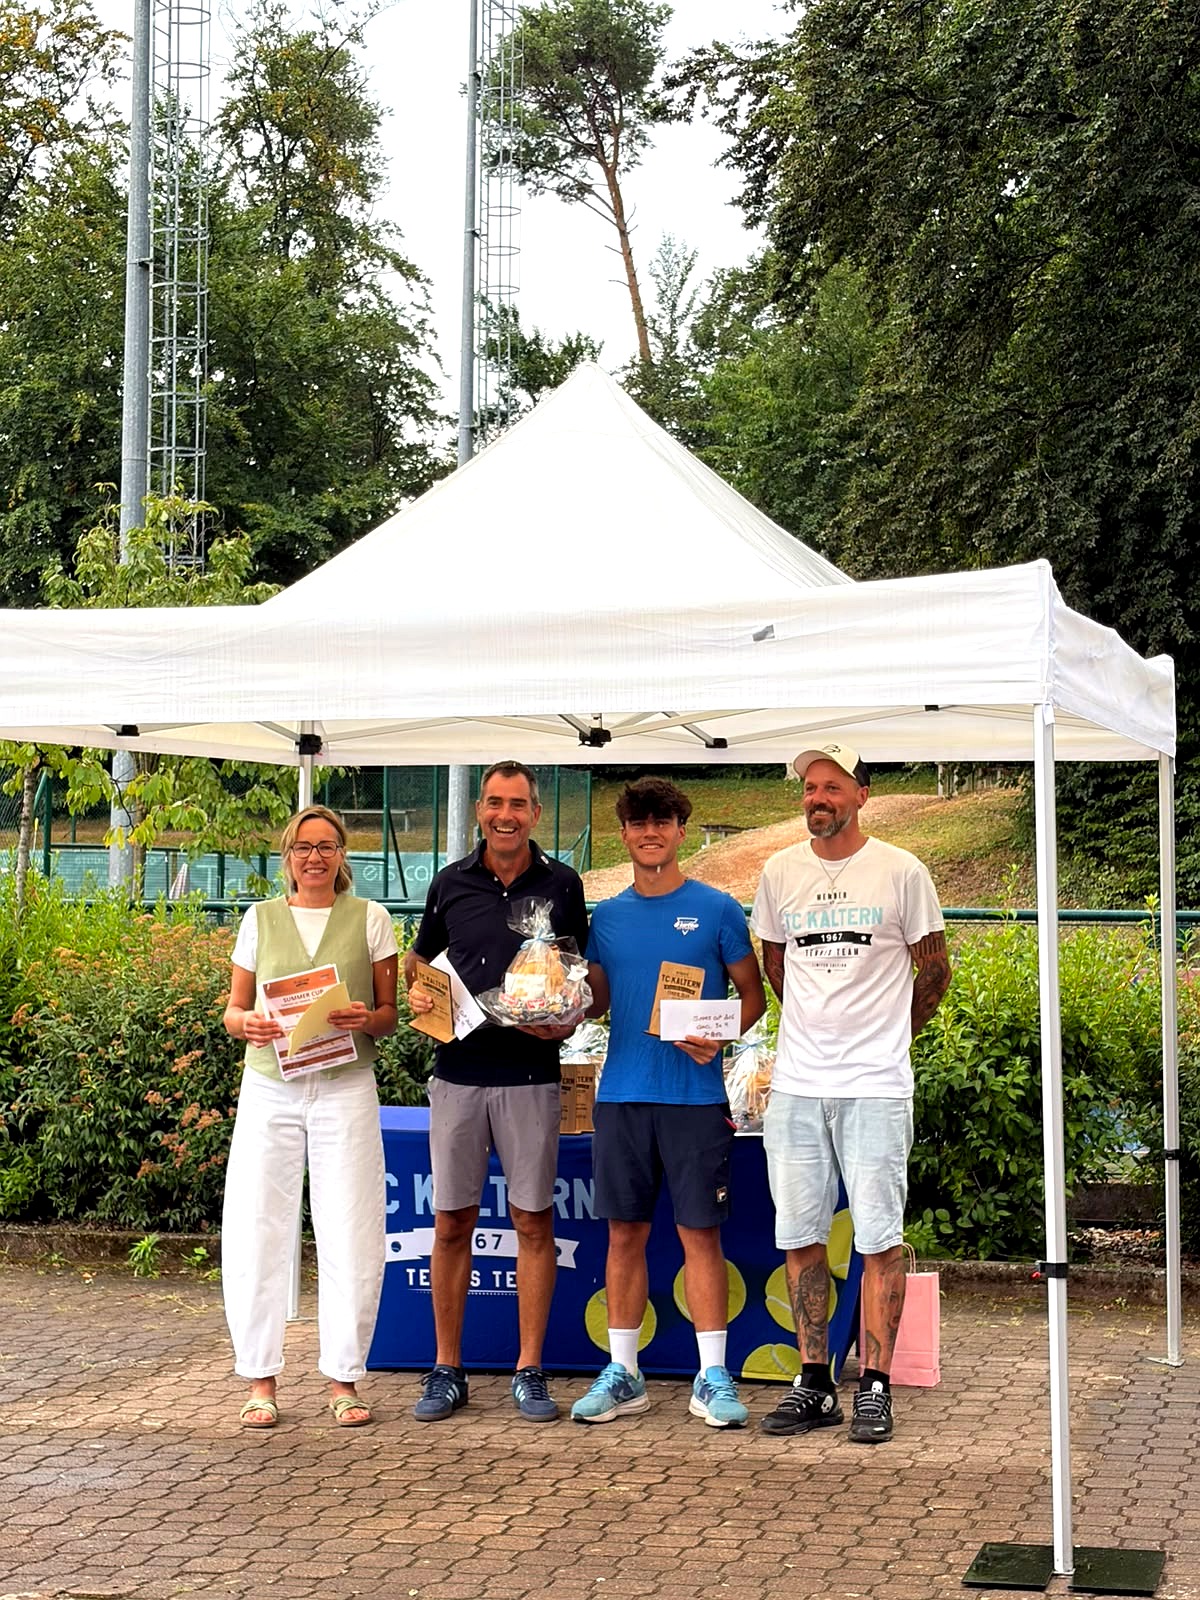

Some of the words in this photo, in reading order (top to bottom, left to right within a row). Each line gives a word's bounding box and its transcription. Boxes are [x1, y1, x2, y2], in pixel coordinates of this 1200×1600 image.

[816, 891, 847, 901] MEMBER
[784, 911, 802, 933] TC
[806, 906, 884, 929] KALTERN
[820, 933, 843, 943] 1967
[836, 947, 859, 956] TEAM
[661, 973, 671, 983] TC
[671, 976, 702, 989] KALTERN
[282, 991, 310, 1003] SUMMER
[311, 988, 324, 998] CUP
[385, 1173, 400, 1214] C
[474, 1233, 503, 1250] 67
[406, 1268, 481, 1287] TES
[492, 1270, 517, 1288] TE
